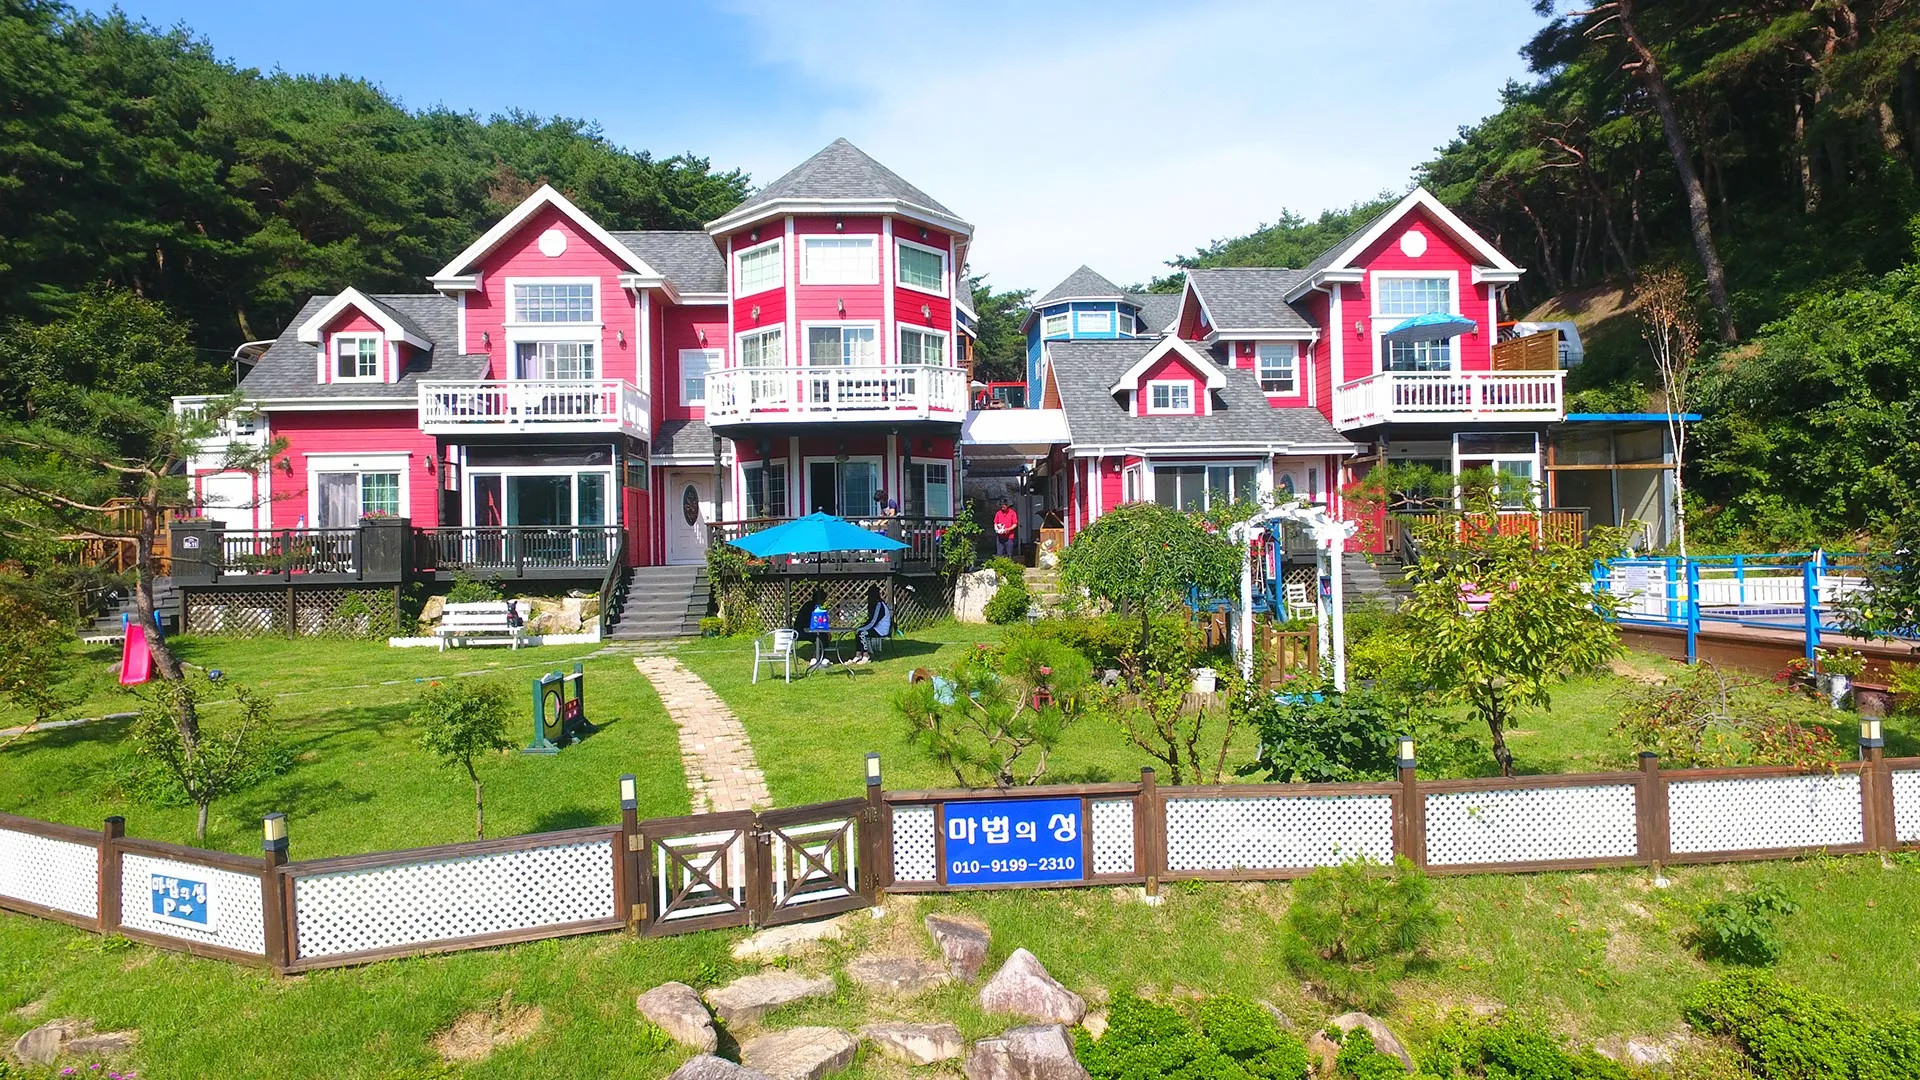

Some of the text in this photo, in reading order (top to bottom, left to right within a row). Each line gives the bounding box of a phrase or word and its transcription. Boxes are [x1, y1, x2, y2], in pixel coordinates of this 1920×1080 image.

[948, 813, 1077, 845] 마법의 성
[952, 856, 1076, 875] 010-9199-2310
[152, 877, 206, 904] 마법의 성
[163, 898, 176, 916] P
